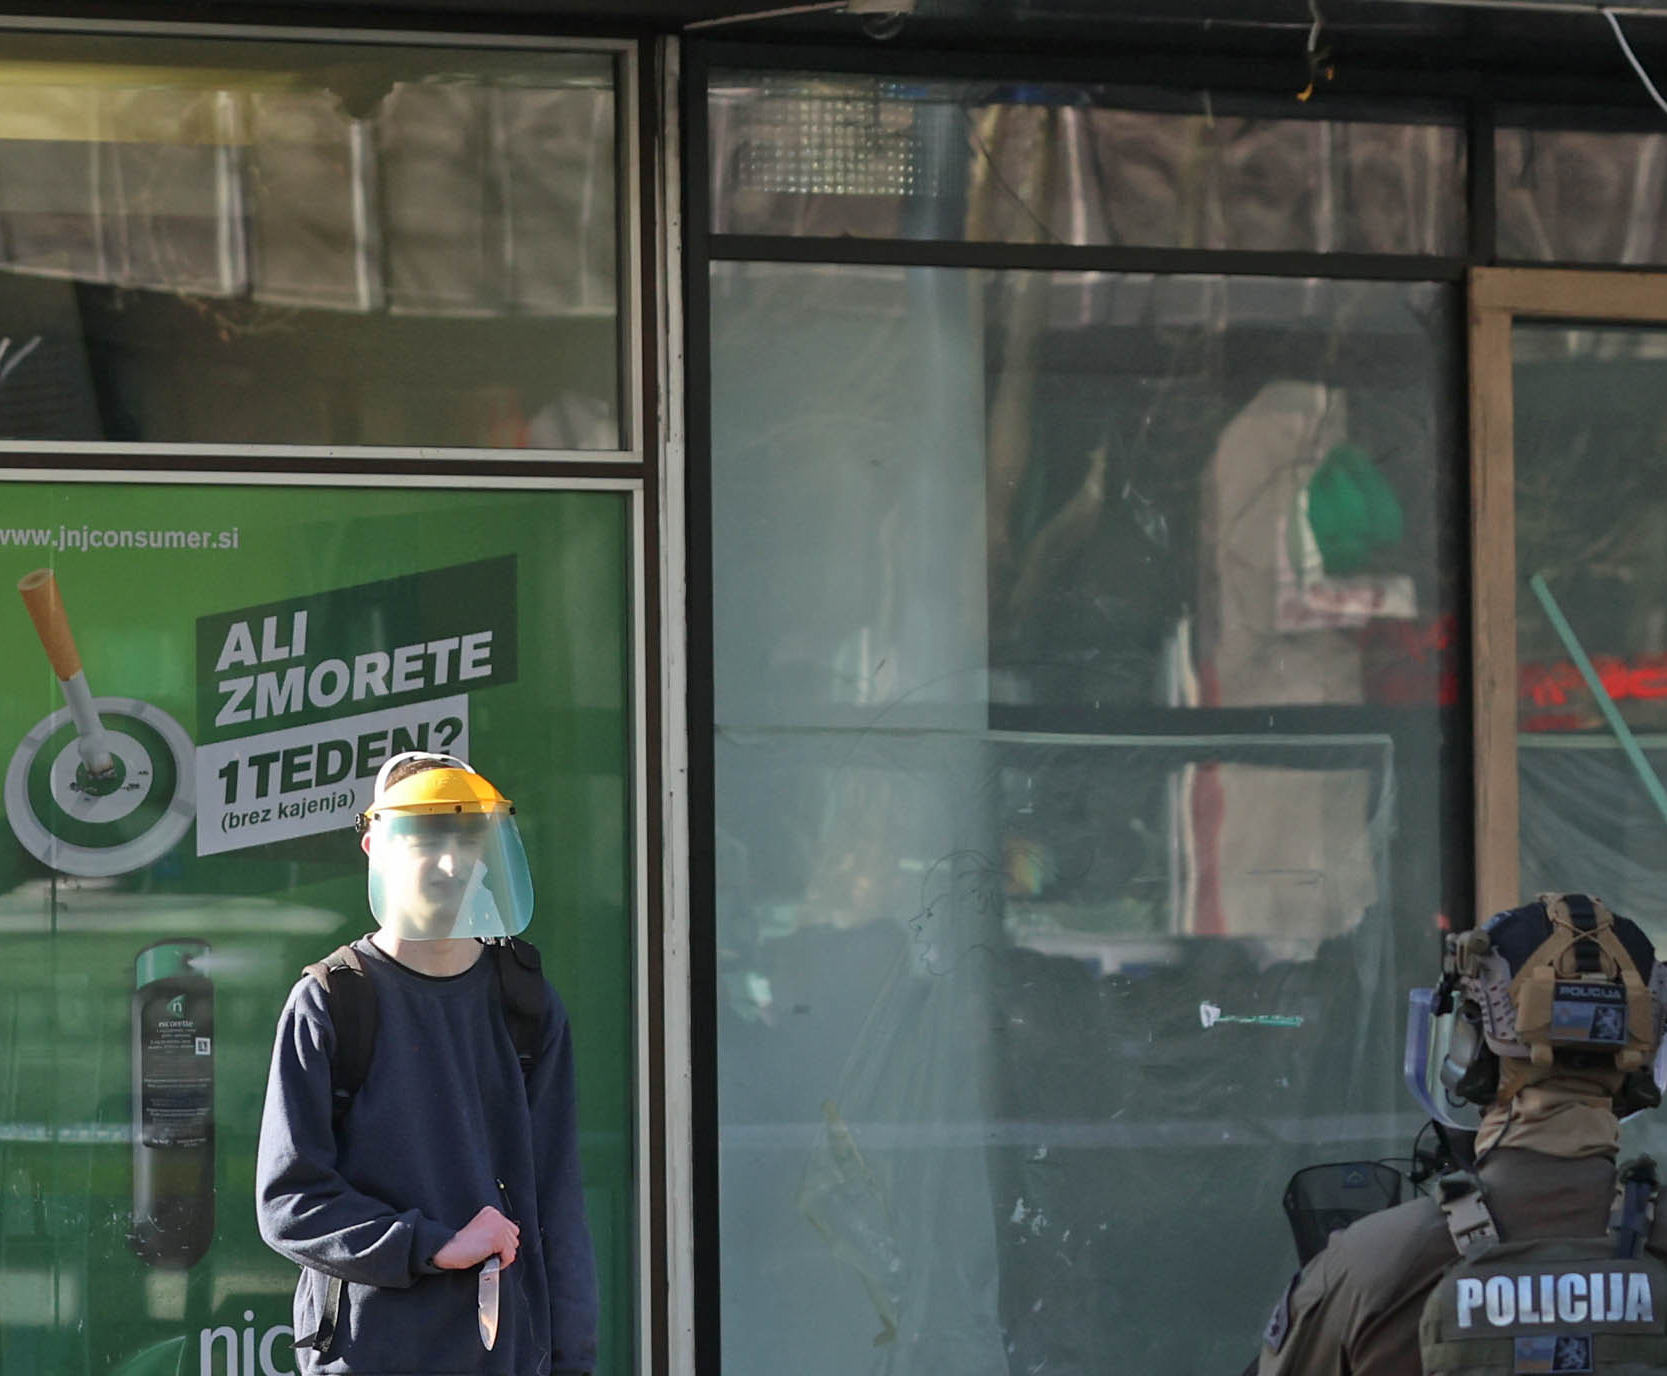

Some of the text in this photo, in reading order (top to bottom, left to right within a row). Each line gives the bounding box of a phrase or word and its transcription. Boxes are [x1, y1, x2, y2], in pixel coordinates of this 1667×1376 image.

[215, 610, 308, 672] ALI
[215, 631, 493, 727] ZMORETE
[218, 760, 239, 804] 1
[222, 788, 355, 832] (brez kajenja)
[1558, 986, 1622, 999] POLICIJA
[1456, 1272, 1653, 1329] POLICIJA
